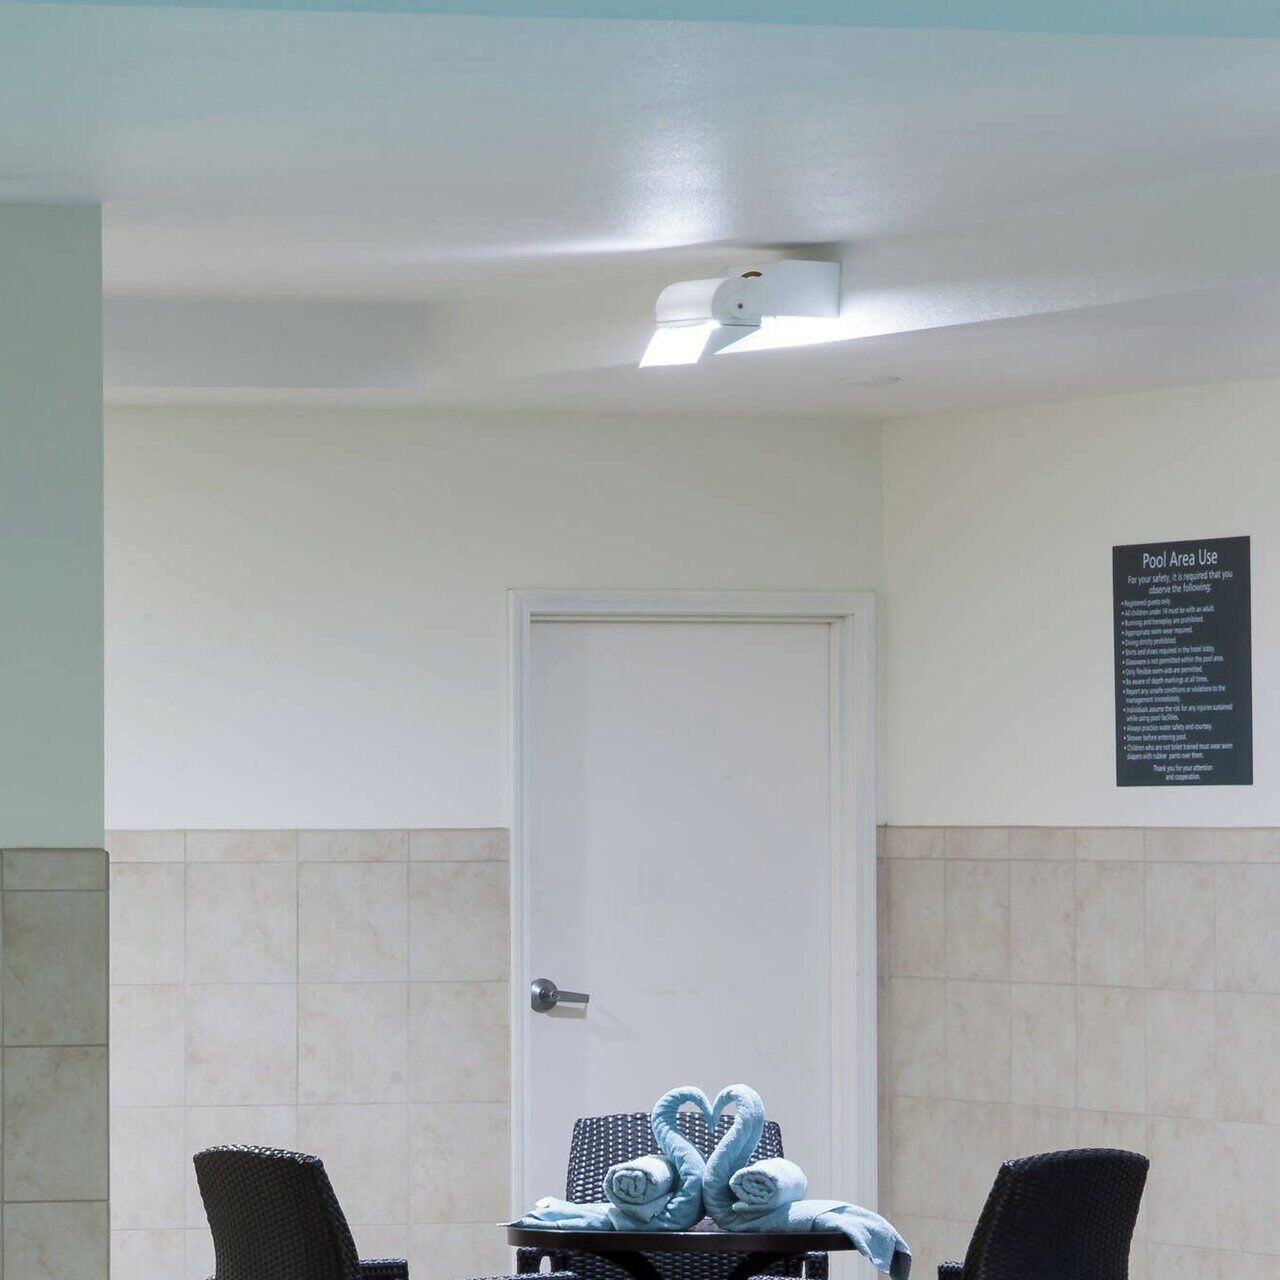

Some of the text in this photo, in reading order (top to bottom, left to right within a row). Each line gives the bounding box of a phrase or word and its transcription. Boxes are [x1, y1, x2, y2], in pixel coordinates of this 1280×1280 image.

[1143, 549, 1218, 568] Pool Area Use
[1128, 576, 1136, 584] For
[1138, 576, 1151, 585] your
[1184, 571, 1207, 581] required
[1209, 570, 1220, 579] that
[1222, 570, 1233, 580] you
[1172, 584, 1182, 592] the
